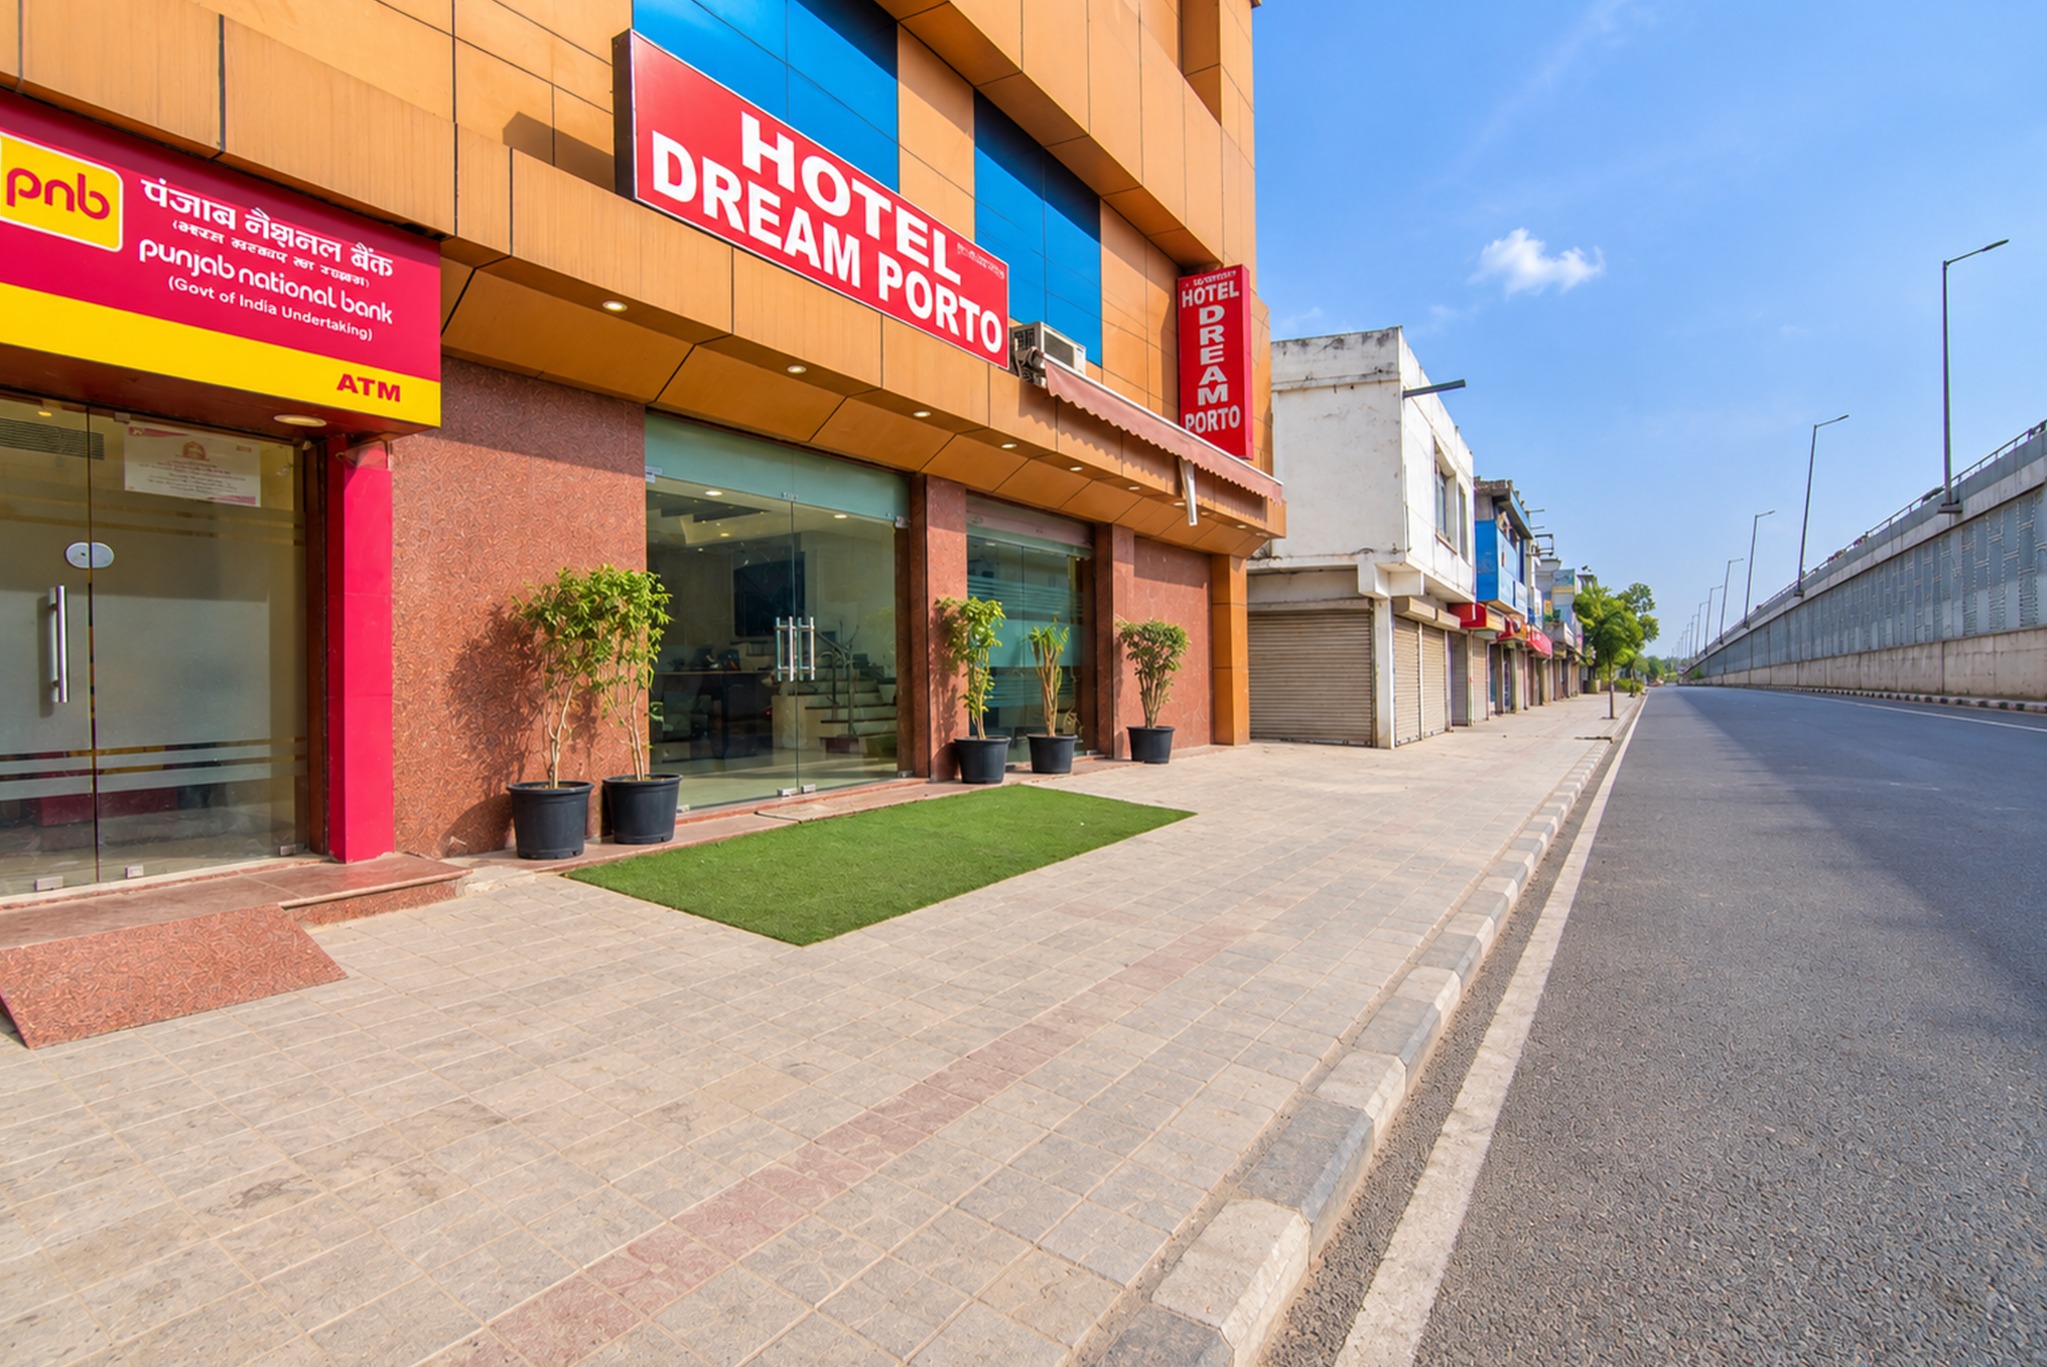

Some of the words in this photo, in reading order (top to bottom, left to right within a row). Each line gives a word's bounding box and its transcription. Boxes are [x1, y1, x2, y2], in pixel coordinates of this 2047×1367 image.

[6, 167, 110, 220] pnb
[140, 177, 236, 230] पंजाब
[350, 242, 394, 277] बैंक
[741, 110, 962, 286] HOTEL
[652, 129, 860, 288] DREAM
[878, 251, 1003, 354] PORTO
[139, 239, 236, 279] punjab
[239, 268, 337, 309] national
[340, 290, 393, 324] bank
[168, 275, 215, 299] (Govt
[219, 292, 236, 304] of
[239, 294, 278, 316] India
[281, 305, 373, 342] Undertaking)
[1181, 281, 1240, 309] HOTEL
[336, 373, 401, 402] ATM
[1197, 304, 1229, 406] DREAM
[1185, 405, 1241, 434] PORTO
